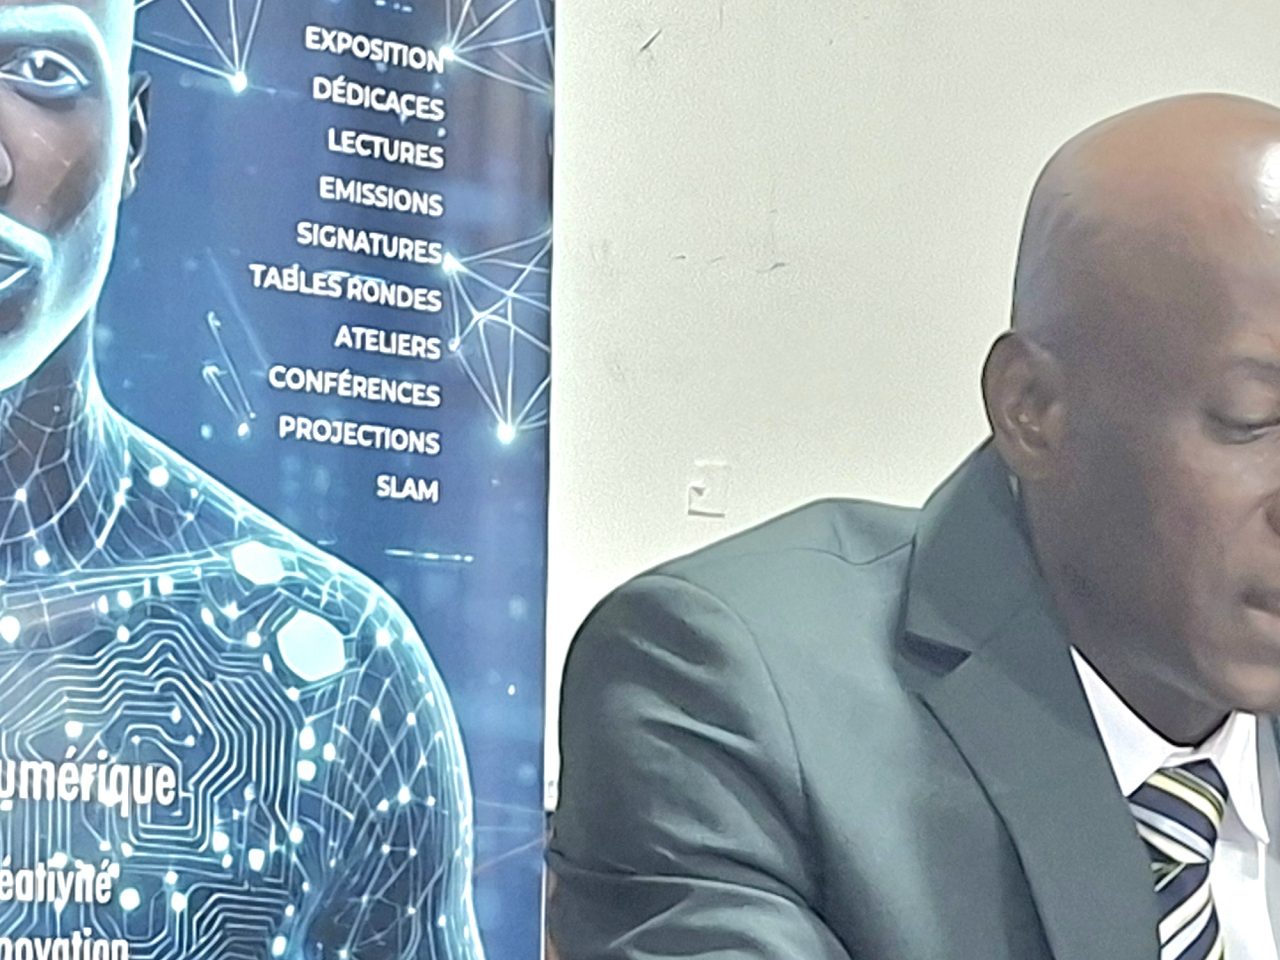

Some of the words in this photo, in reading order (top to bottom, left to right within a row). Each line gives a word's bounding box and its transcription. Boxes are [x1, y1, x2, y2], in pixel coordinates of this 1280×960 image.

[305, 25, 445, 73] EXPOSITION
[312, 76, 445, 121] DÉDICACES
[328, 128, 445, 169] LECTURES
[319, 176, 444, 216] EMISSIONS
[297, 222, 443, 265] SIGNATURES
[249, 263, 341, 298] TABLES
[347, 278, 442, 312] RONDES
[335, 325, 441, 360] ATELIERS
[268, 365, 441, 407] CONFÉRENCES
[279, 416, 440, 455] PROJECTIONS
[376, 475, 439, 503] SLAM
